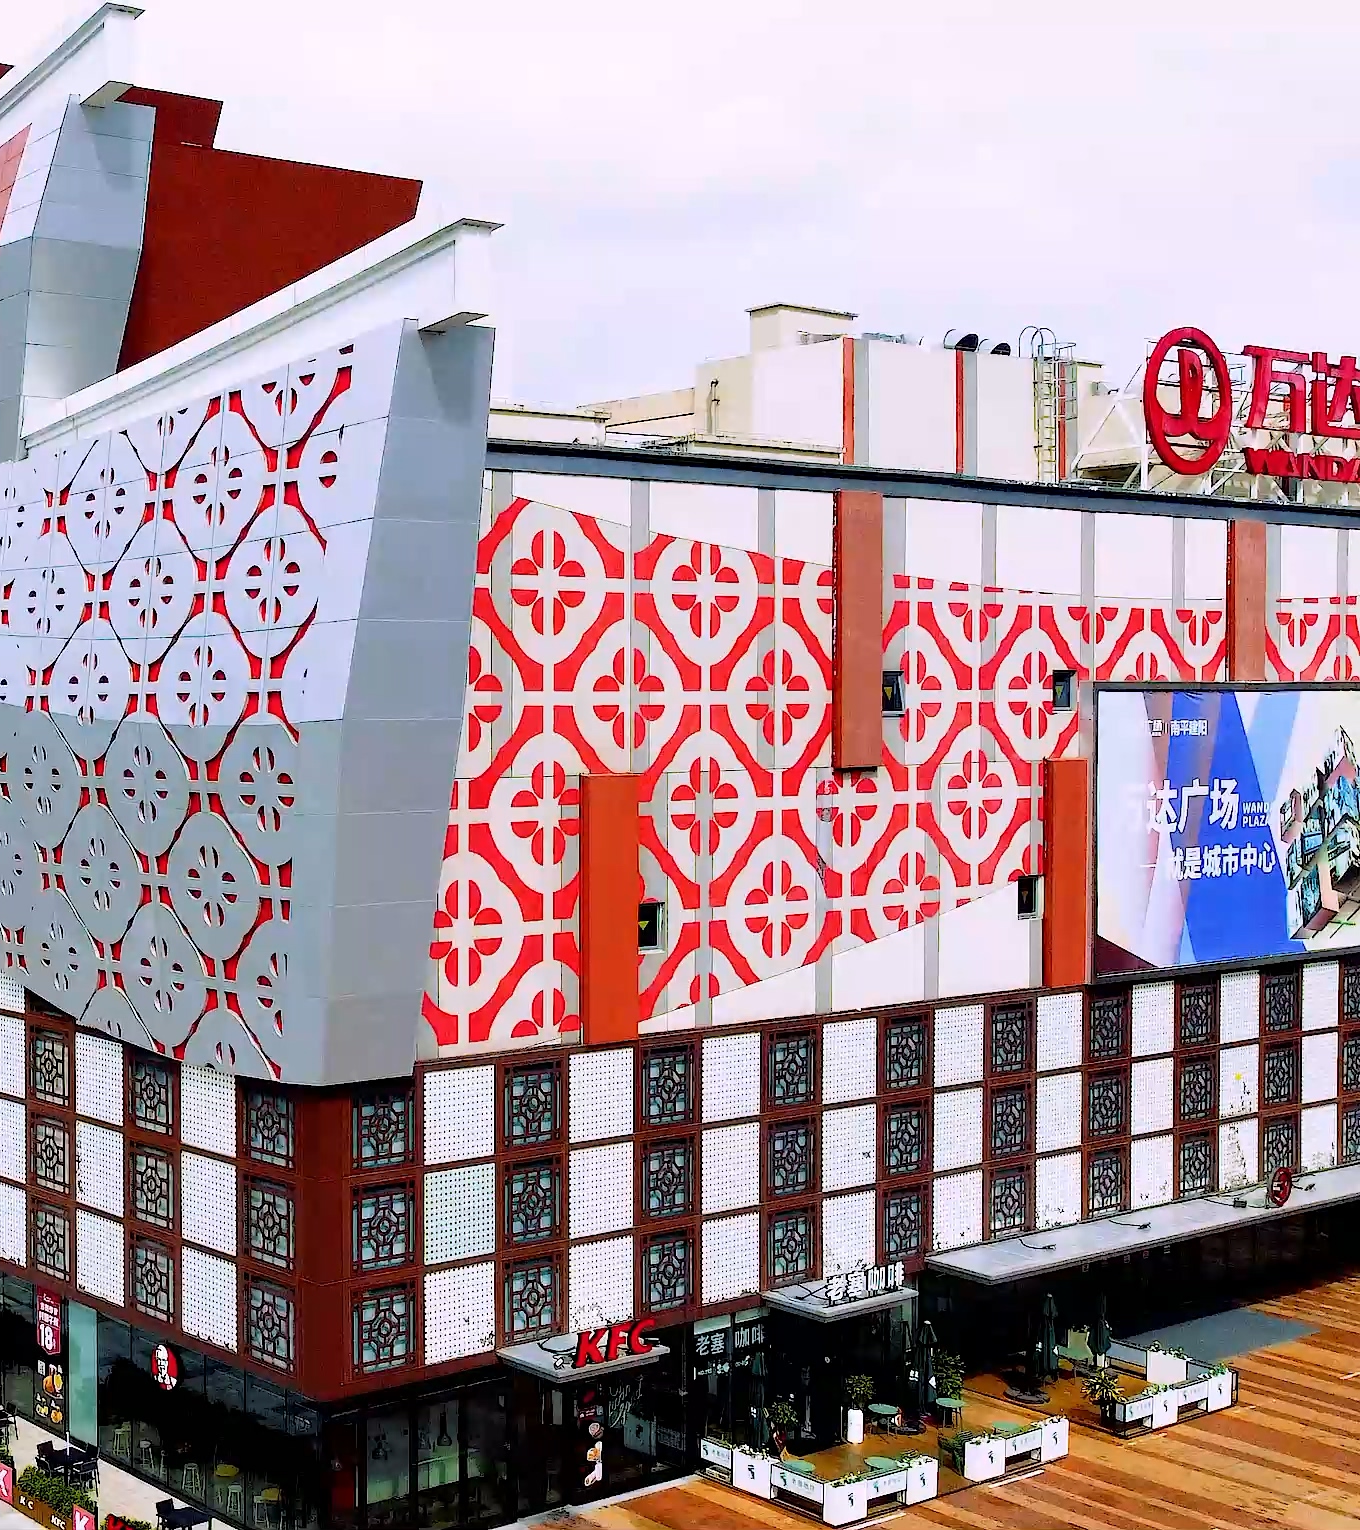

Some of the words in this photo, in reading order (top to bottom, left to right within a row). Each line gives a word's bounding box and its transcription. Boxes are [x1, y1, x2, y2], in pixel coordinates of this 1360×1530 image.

[1126, 778, 1240, 836] 达广场
[1242, 802, 1270, 814] WAND
[40, 1324, 54, 1350] 18
[575, 1318, 656, 1368] KFC
[51, 1514, 66, 1530] KFC
